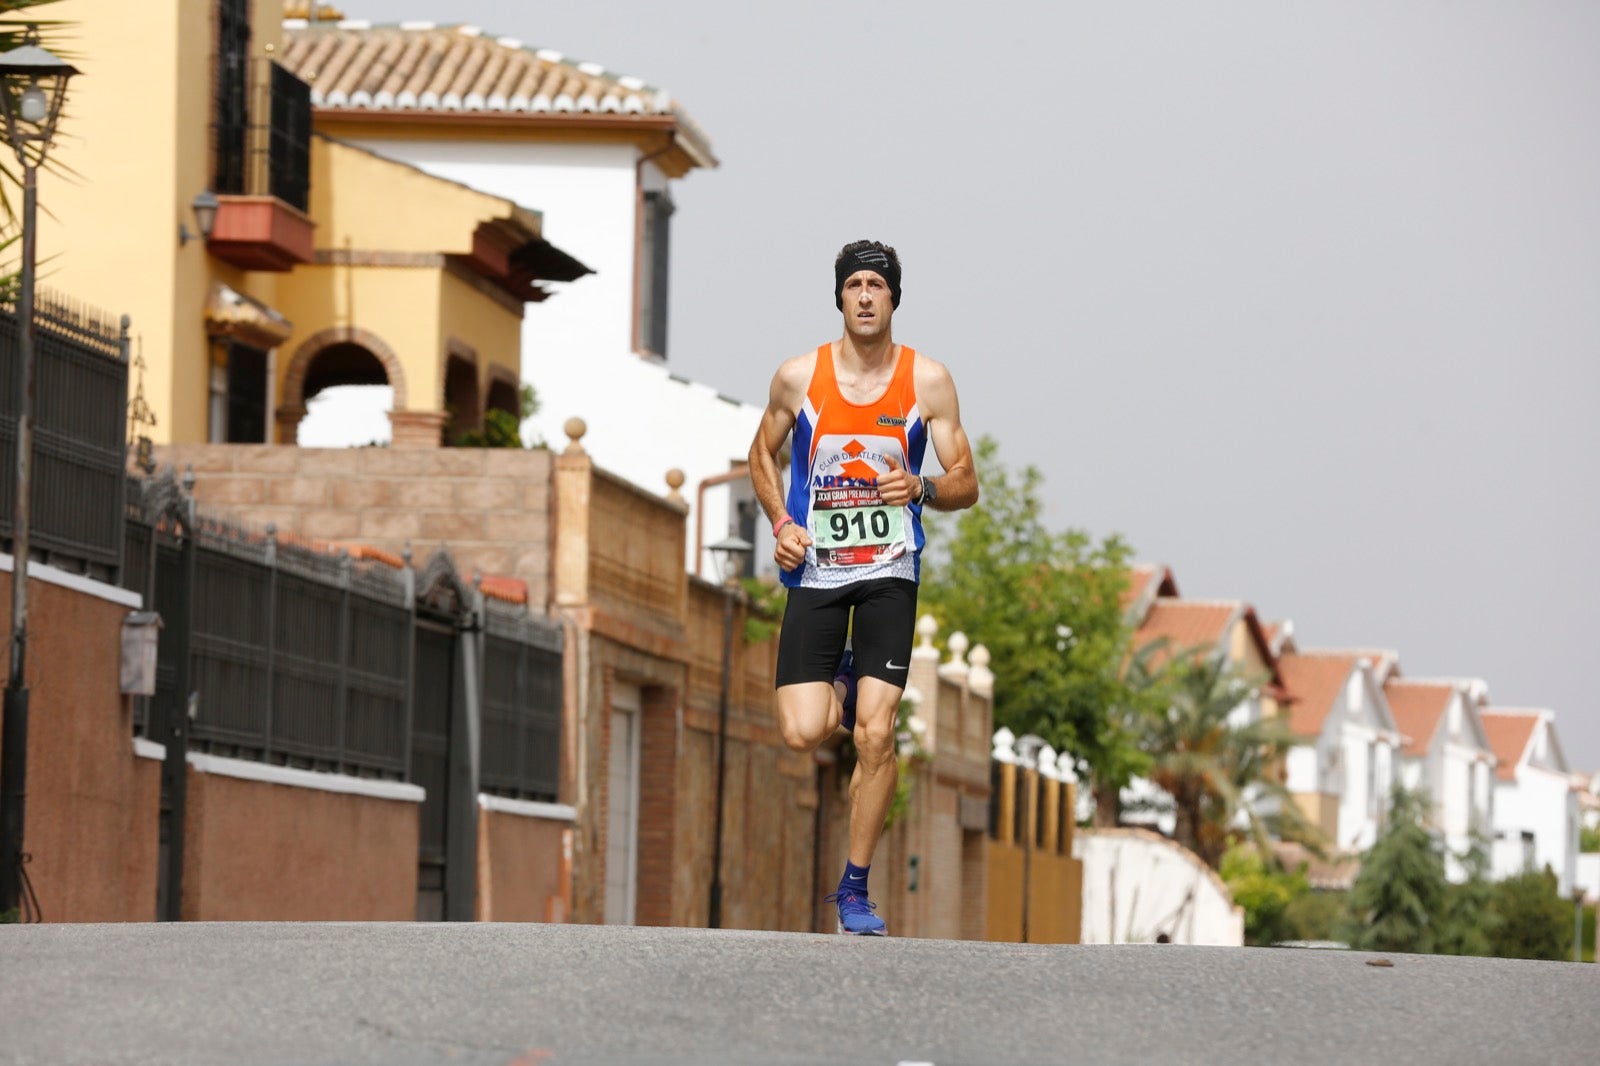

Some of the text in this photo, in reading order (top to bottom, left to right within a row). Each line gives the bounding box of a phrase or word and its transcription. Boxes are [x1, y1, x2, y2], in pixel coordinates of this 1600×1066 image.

[819, 455, 840, 471] CLUB
[841, 451, 855, 460] DE
[832, 490, 847, 500] GRAN
[848, 489, 870, 499] PREMIO
[871, 490, 878, 498] DE
[830, 509, 889, 542] 910
